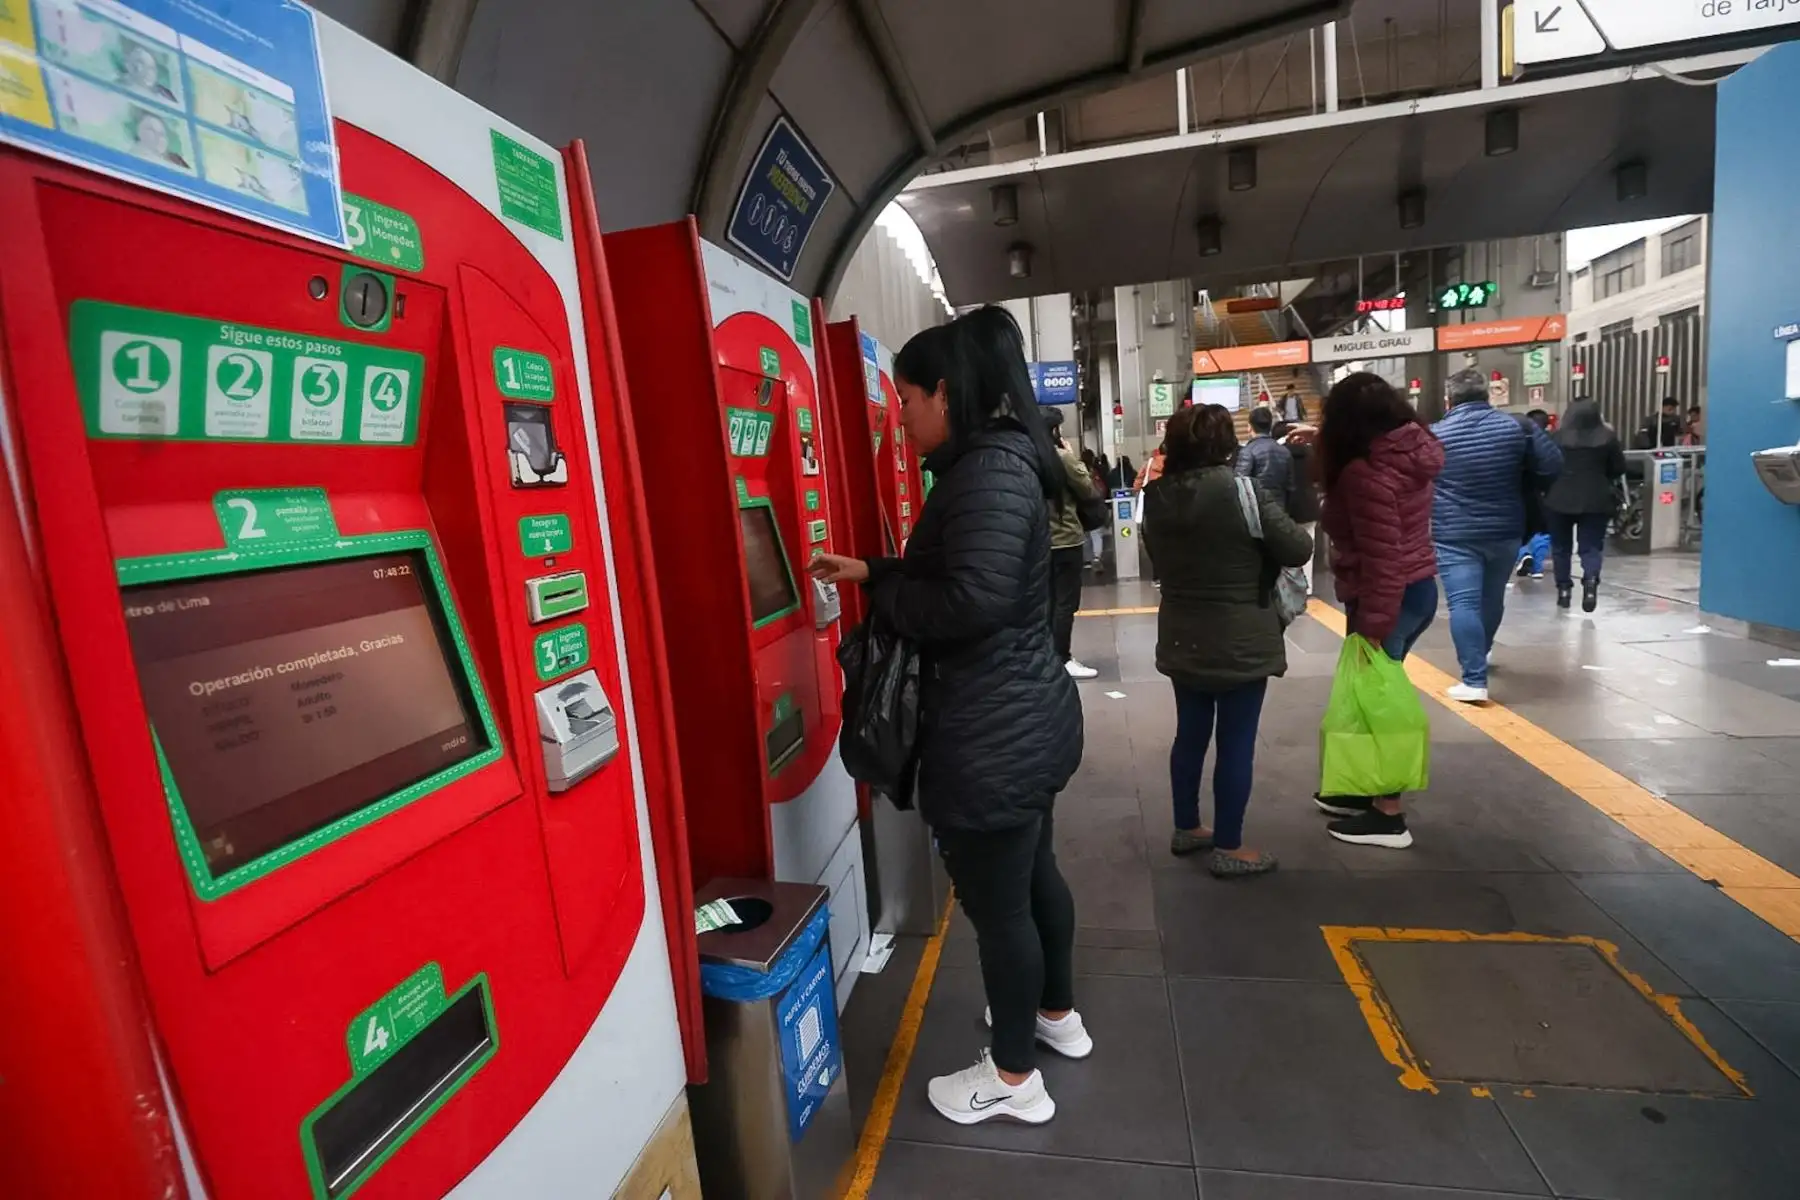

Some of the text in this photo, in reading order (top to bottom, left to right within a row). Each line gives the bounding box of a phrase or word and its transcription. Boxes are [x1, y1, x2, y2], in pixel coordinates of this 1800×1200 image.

[1702, 0, 1731, 17] de
[343, 203, 366, 246] 3
[372, 211, 409, 232] Ingresa
[372, 225, 415, 248] Monedas
[220, 325, 342, 356] Sigue estos pasos
[1333, 337, 1411, 352] MIGUEL GRAU
[125, 345, 160, 389] 1
[502, 357, 521, 390] 1
[1529, 352, 1544, 368] S
[226, 355, 254, 396] 2
[309, 365, 332, 402] 3
[374, 373, 396, 408] 4
[1154, 386, 1167, 401] S
[732, 420, 739, 439] 2
[227, 498, 267, 539] 2
[157, 601, 175, 613] de
[176, 596, 211, 610] Lima
[559, 630, 581, 643] Ingresa
[560, 642, 583, 654] Billetes
[189, 633, 405, 696] Operación completada, Gracias
[541, 640, 557, 673] 3
[297, 692, 332, 708] Adulto
[362, 1016, 389, 1057] 4
